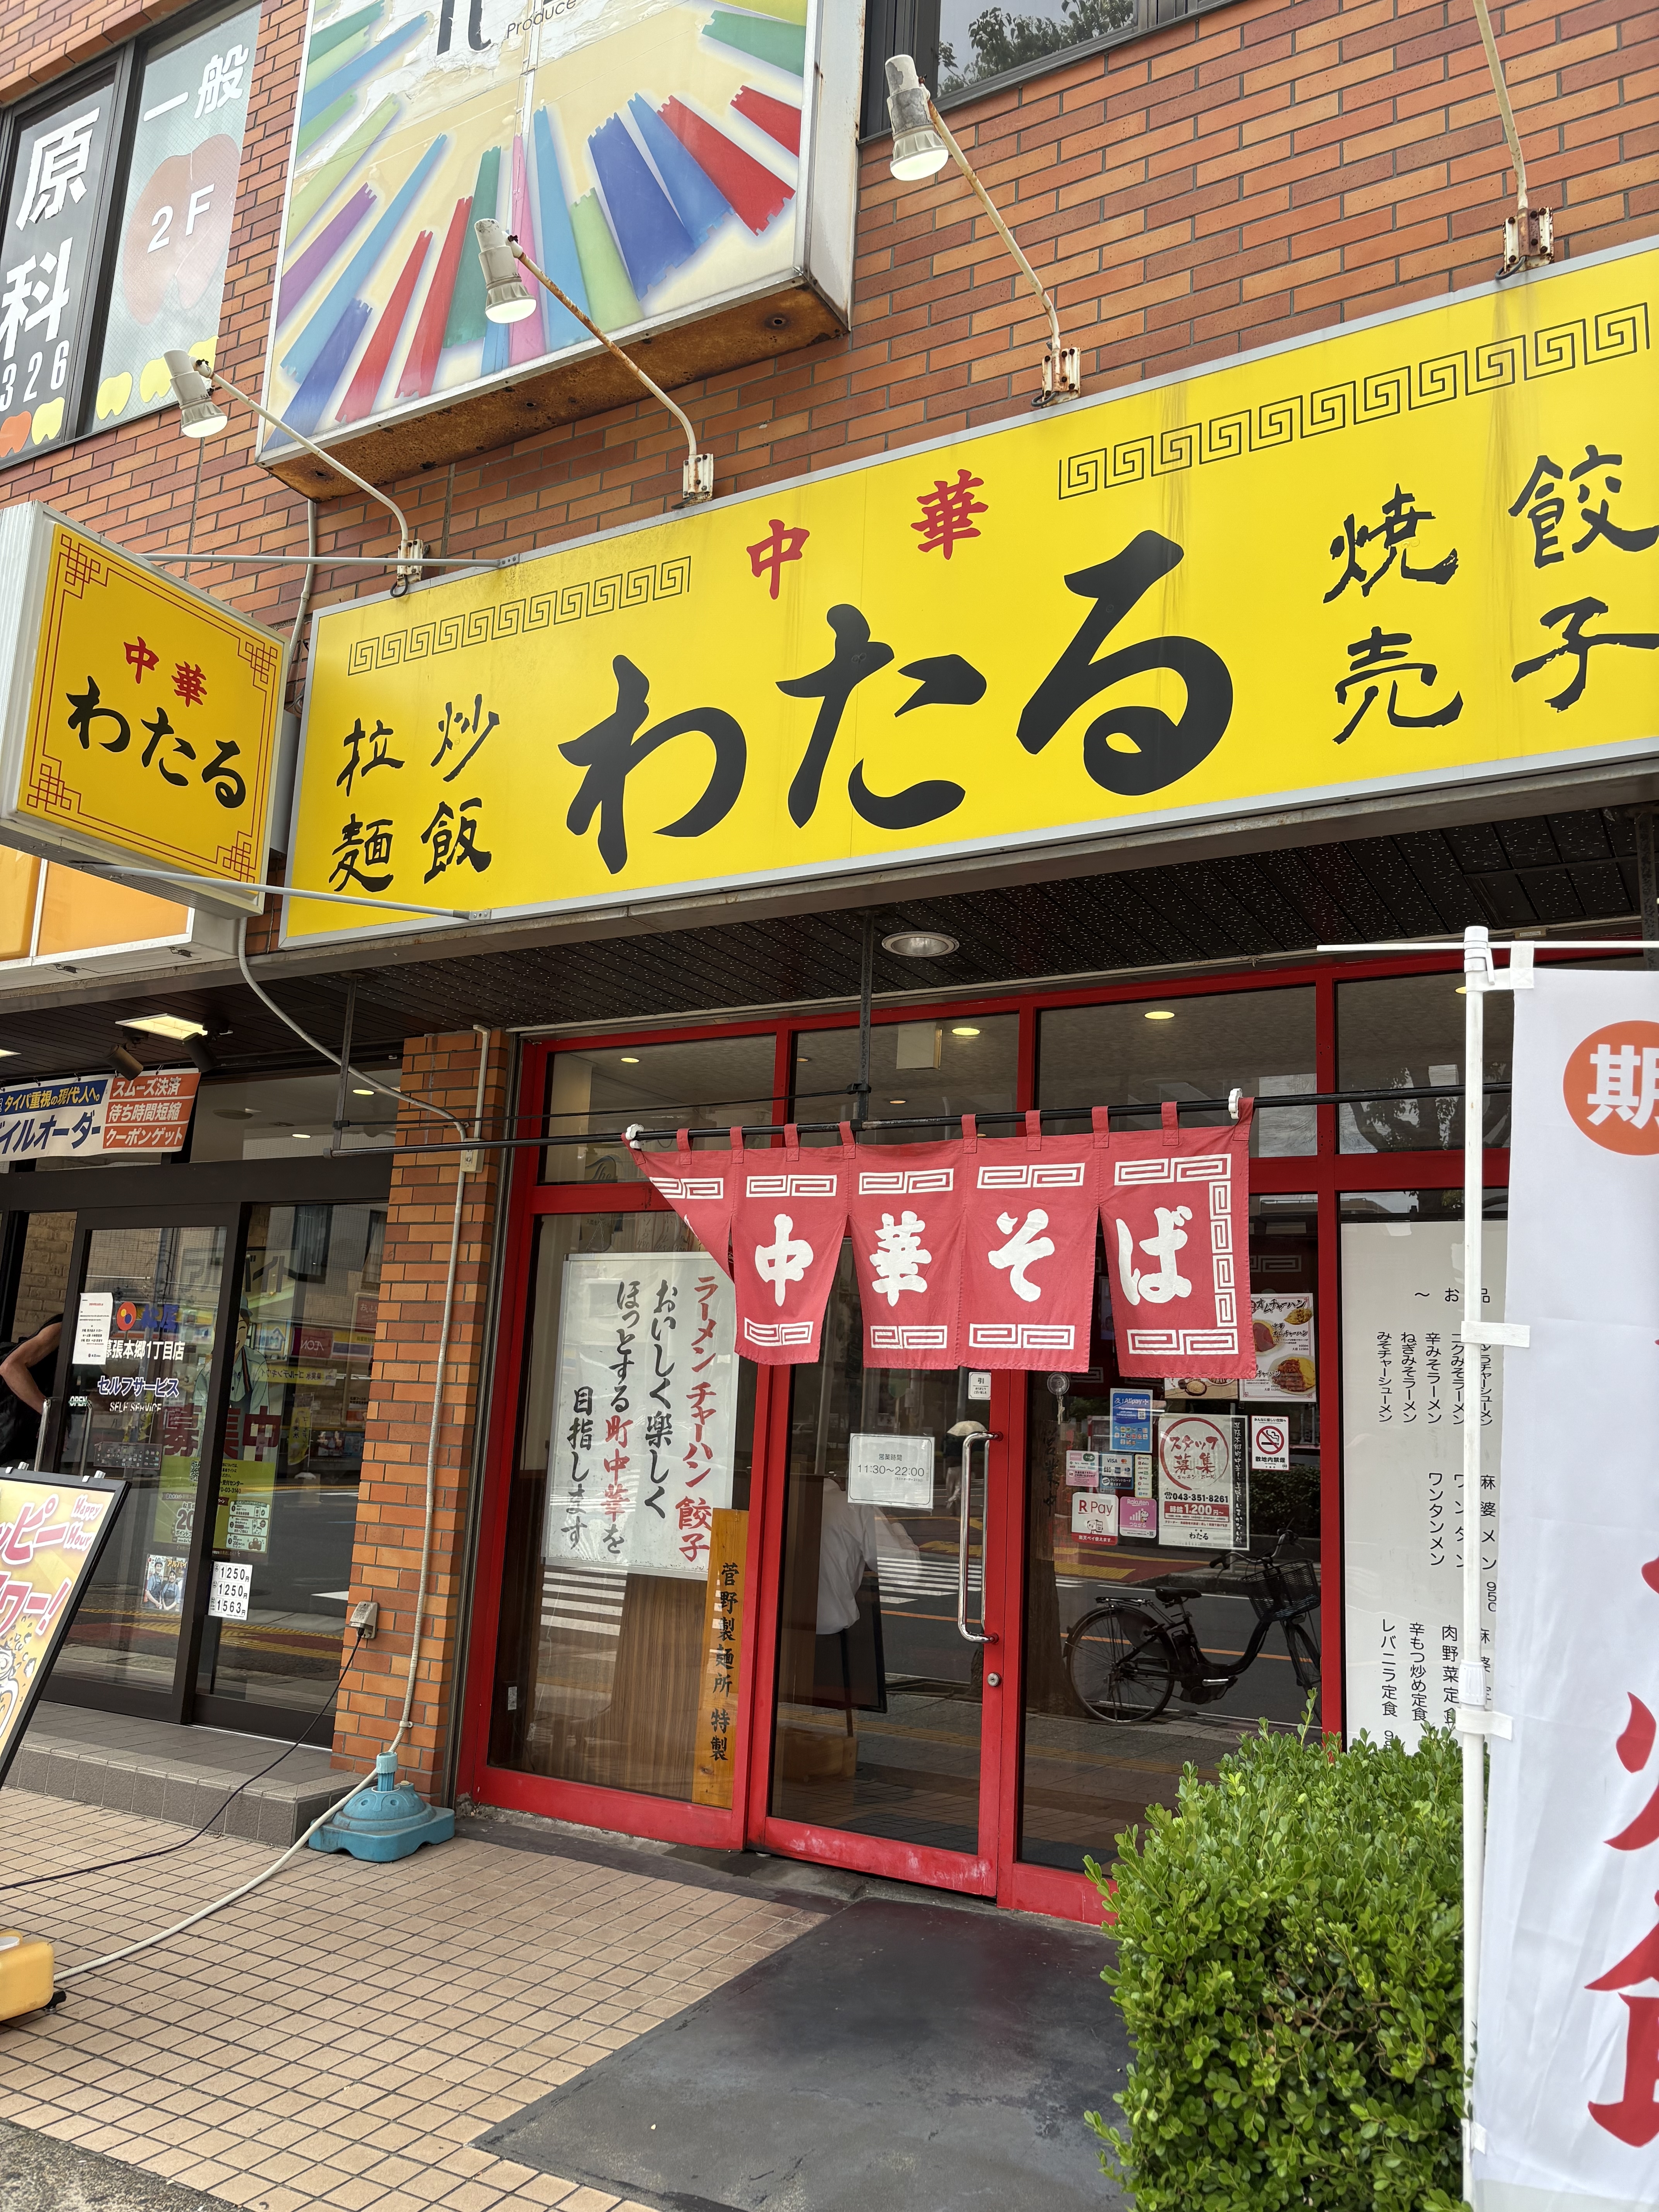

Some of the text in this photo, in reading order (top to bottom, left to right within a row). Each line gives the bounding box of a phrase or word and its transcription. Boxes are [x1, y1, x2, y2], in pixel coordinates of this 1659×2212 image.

[507, 0, 577, 39] Produce
[143, 44, 250, 122] 一般
[15, 106, 100, 232] 原
[0, 237, 74, 361] 科
[746, 469, 989, 600] 中華
[1508, 444, 1659, 713] 餃子
[1322, 483, 1463, 745] 焼売
[123, 636, 208, 708] 中華
[557, 529, 1233, 875] わたる
[66, 675, 247, 809] わたる
[421, 693, 501, 884] 炒飯
[328, 718, 405, 893] 拉麺
[0, 1109, 101, 1154] イルオーダー
[108, 1102, 182, 1123] 待ち時間短縮
[113, 1077, 182, 1097] スムーズ決済
[105, 1126, 183, 1147] クーポンゲット
[754, 1205, 1192, 1307] 中華そば
[69, 1396, 88, 1407] OPEN
[98, 1376, 180, 1398] セルフサービス
[602, 1280, 641, 1555] ほっとする町中華を
[644, 1279, 678, 1520] おいしく楽しく
[675, 1276, 719, 1563] ラーメン チャーハン 餃子
[1377, 1331, 1392, 1422] みそチャーシューメン
[1401, 1332, 1417, 1423] ねぎみそラーメン
[1425, 1332, 1441, 1424] 辛みそラーメン
[560, 1386, 594, 1549] 目指します
[1170, 1435, 1219, 1452] スタッフ
[1173, 1453, 1216, 1474] 募集
[1091, 1501, 1113, 1516] Pay
[1173, 1493, 1228, 1503] 043-351-8261
[1189, 1532, 1209, 1540] わたる
[1429, 1473, 1444, 1566] ワンタンメン
[709, 1562, 739, 1762] 菅野製麺所 特製
[1381, 1619, 1398, 1717] レバニラ定食
[1409, 1622, 1428, 1721] 辛もつ炒め定食
